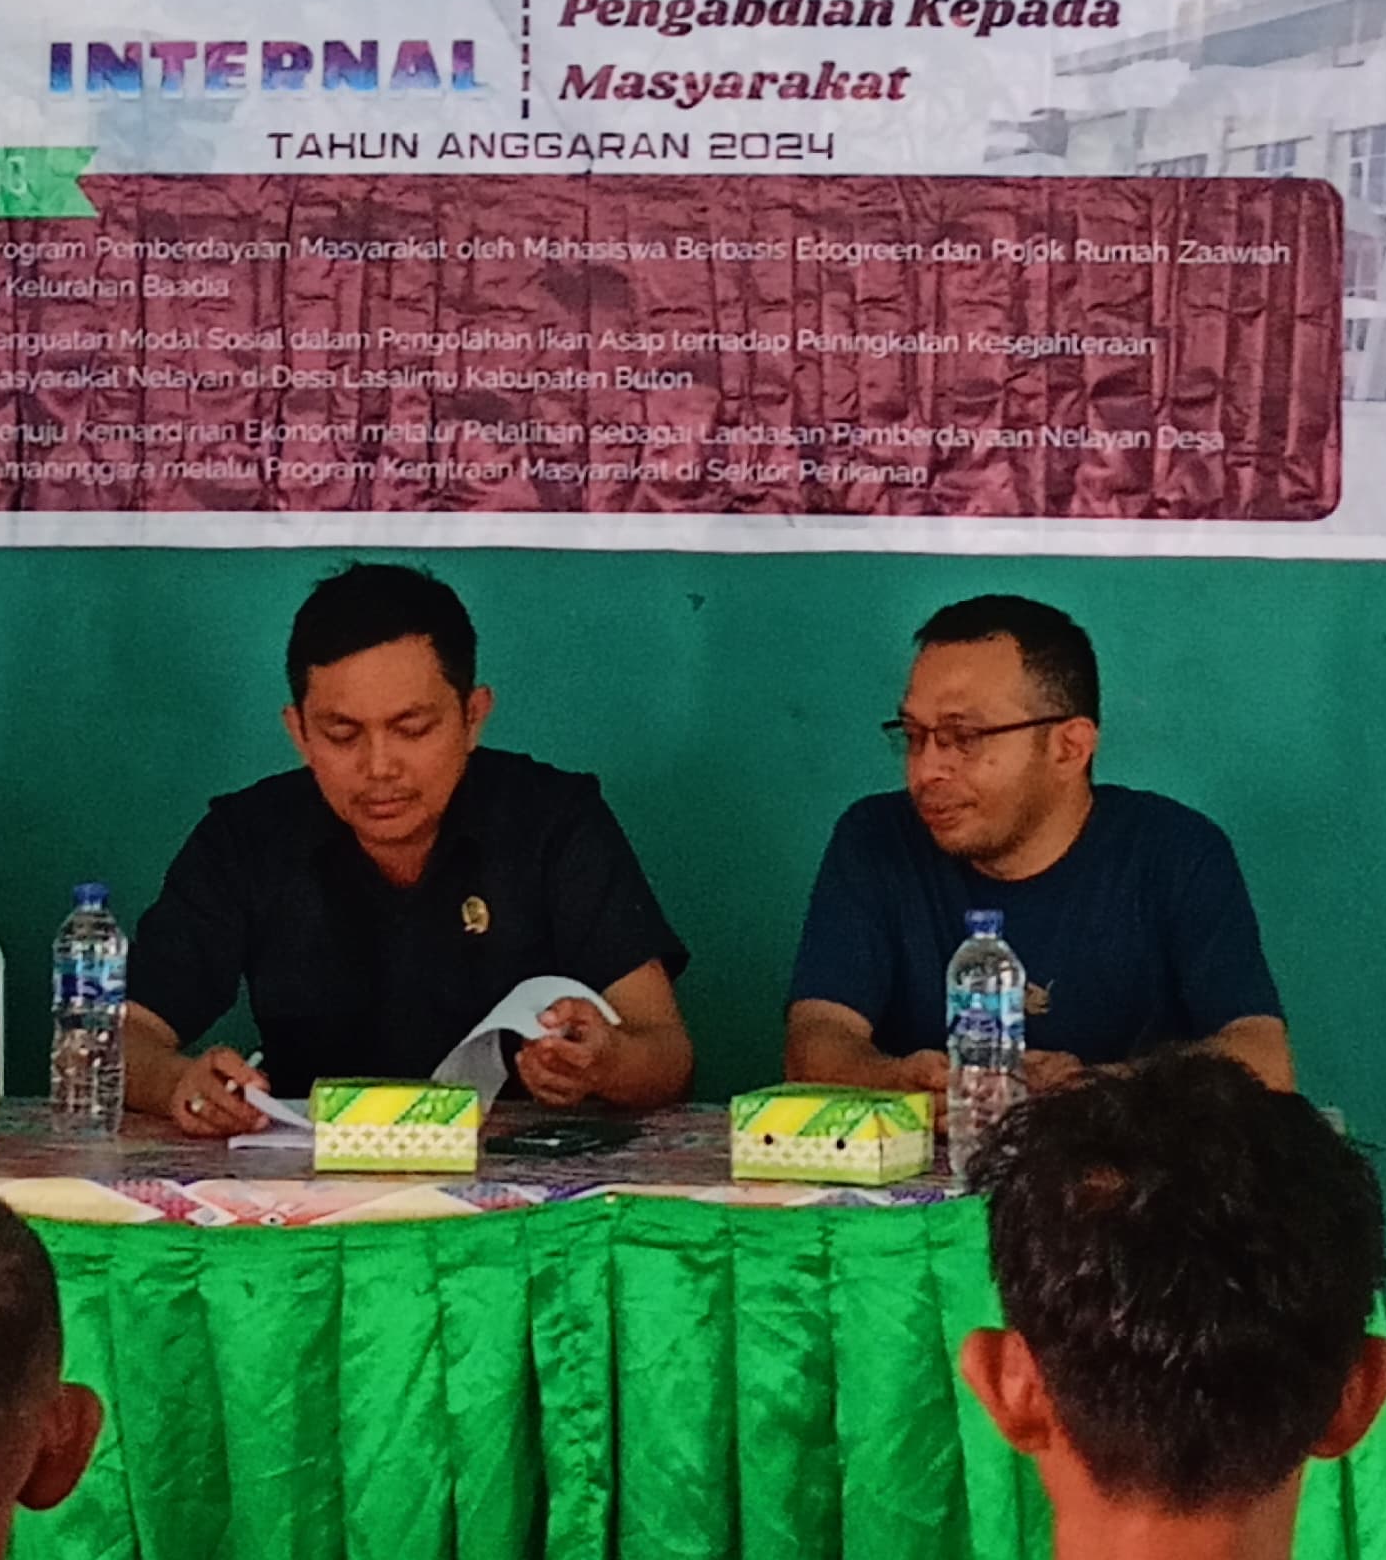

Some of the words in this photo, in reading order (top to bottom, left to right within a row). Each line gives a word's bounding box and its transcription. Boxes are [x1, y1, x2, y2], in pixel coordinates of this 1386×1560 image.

[49, 40, 490, 94] INTERNAL
[559, 62, 911, 107] Masyarakat
[268, 133, 419, 159] TAHUN
[437, 133, 690, 160] ANGGARAN
[708, 133, 835, 160] 2024
[97, 238, 291, 263] Pemberdayaan
[300, 238, 445, 263] Masyarakat
[457, 238, 514, 260] oleh
[524, 238, 666, 261] Mahasiswa
[675, 238, 787, 261] Berbasis
[932, 239, 980, 262] dan
[993, 239, 1066, 266] Pojok
[1075, 239, 1169, 263] Rumah
[6, 275, 136, 297] Kelurahan
[144, 275, 230, 297] Baadia
[121, 329, 200, 351] Modal
[208, 329, 282, 351] Sosial
[291, 328, 370, 351] dalam
[378, 328, 532, 356] Pengolahan
[539, 328, 591, 351] Ikan
[598, 329, 665, 357] Asap
[673, 328, 790, 358] terhadap
[797, 329, 958, 358] Peningkatan
[967, 331, 1157, 357] Kesejahteraan
[128, 367, 233, 392] Nelayan
[242, 367, 266, 388] di
[272, 367, 336, 389] Desa
[343, 366, 457, 389] Lasalimu
[466, 366, 608, 393] Kabupaten
[616, 366, 693, 390] Buton
[244, 420, 355, 442] Ekonomi
[464, 419, 584, 444] Pelatihan
[589, 421, 691, 448] sebagai
[700, 421, 826, 445] Landasan
[832, 423, 1034, 452] Pemberdayaan
[1039, 424, 1150, 452] Nelayan
[1157, 425, 1224, 450] Desa
[163, 456, 258, 481] melalui
[264, 458, 375, 485] Program
[382, 457, 511, 482] Kemitraan
[520, 457, 669, 485] Masyarakat
[676, 457, 701, 481] di
[707, 458, 791, 482] Sektor
